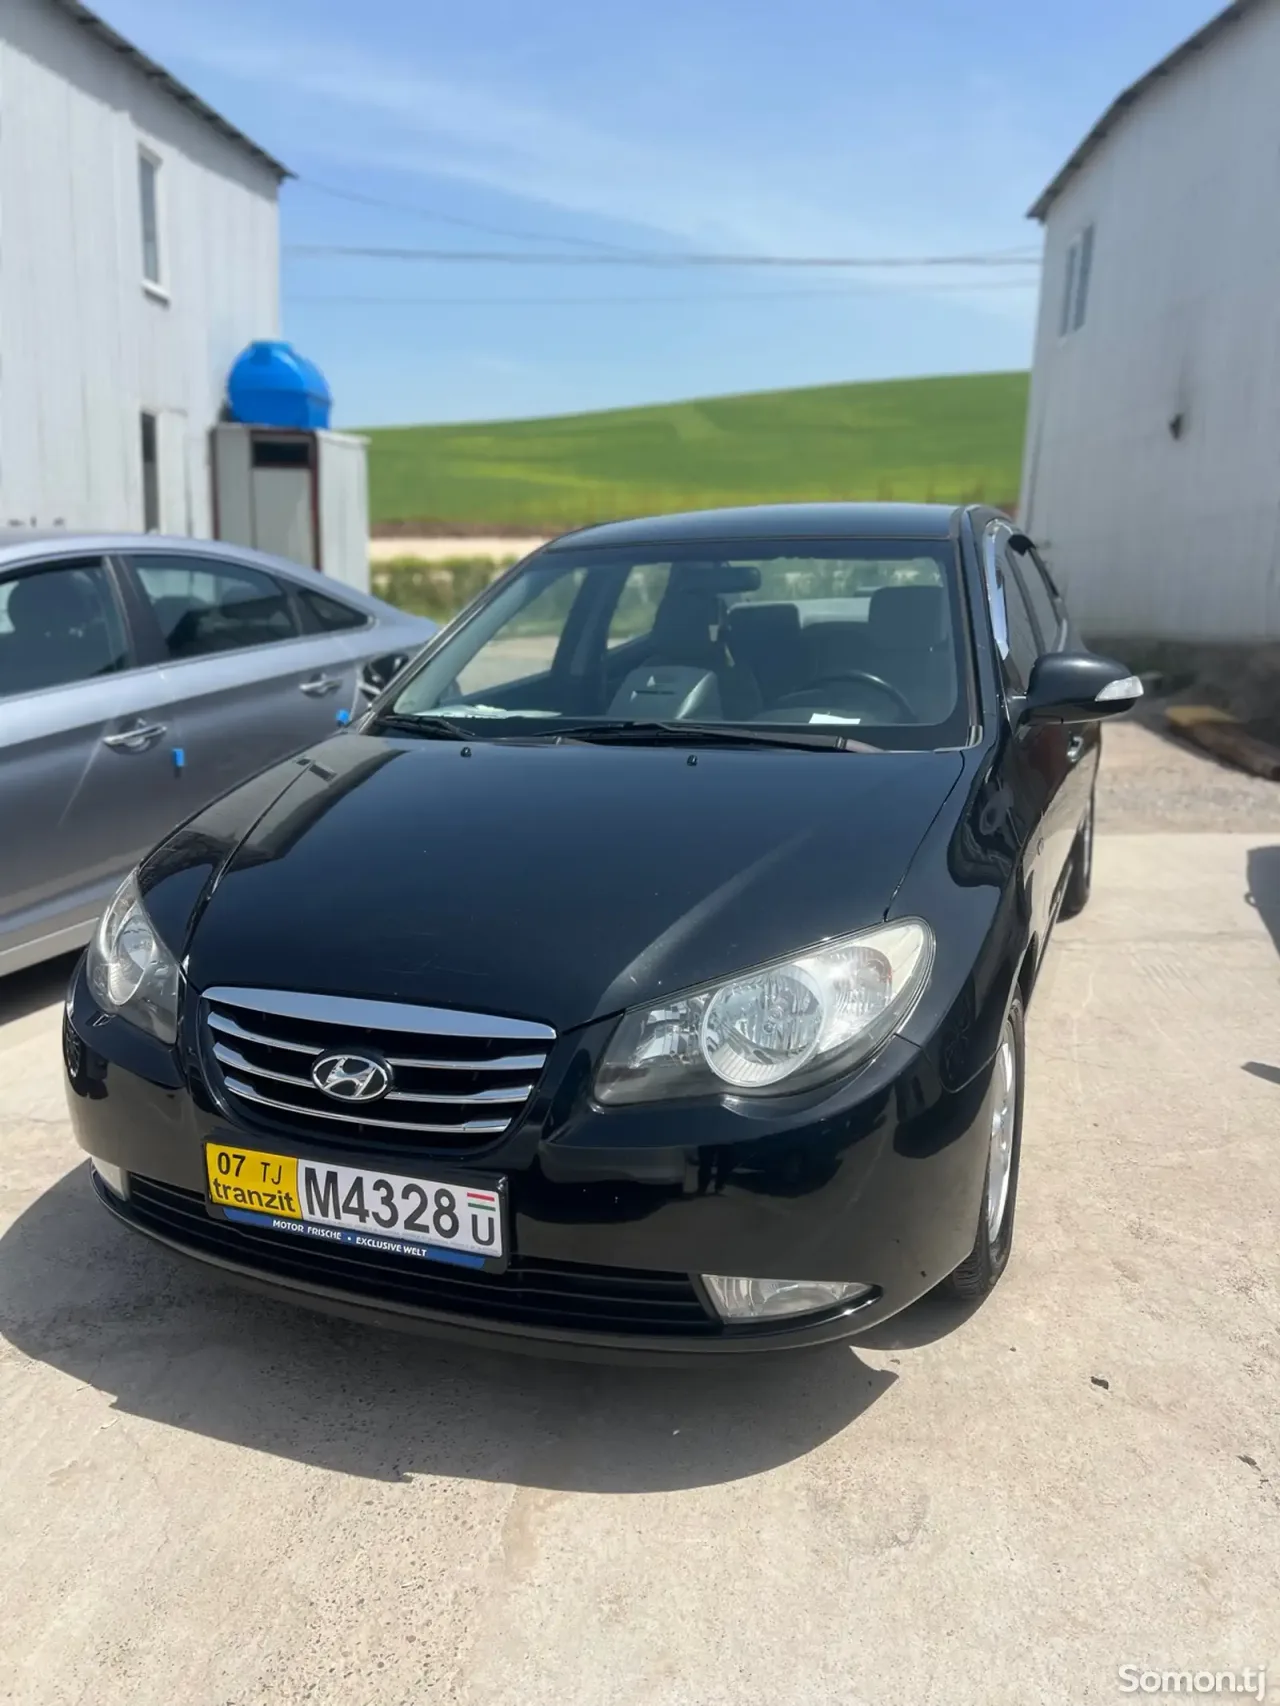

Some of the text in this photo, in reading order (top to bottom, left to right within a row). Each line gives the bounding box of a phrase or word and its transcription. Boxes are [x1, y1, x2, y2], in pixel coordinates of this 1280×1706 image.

[217, 1152, 283, 1185] 07 TJ
[212, 1177, 296, 1212] tranzit
[304, 1167, 460, 1239] M4328
[272, 1219, 427, 1257] MOTOR FRISCHE EXCLUSIVE WELT
[471, 1213, 495, 1246] U
